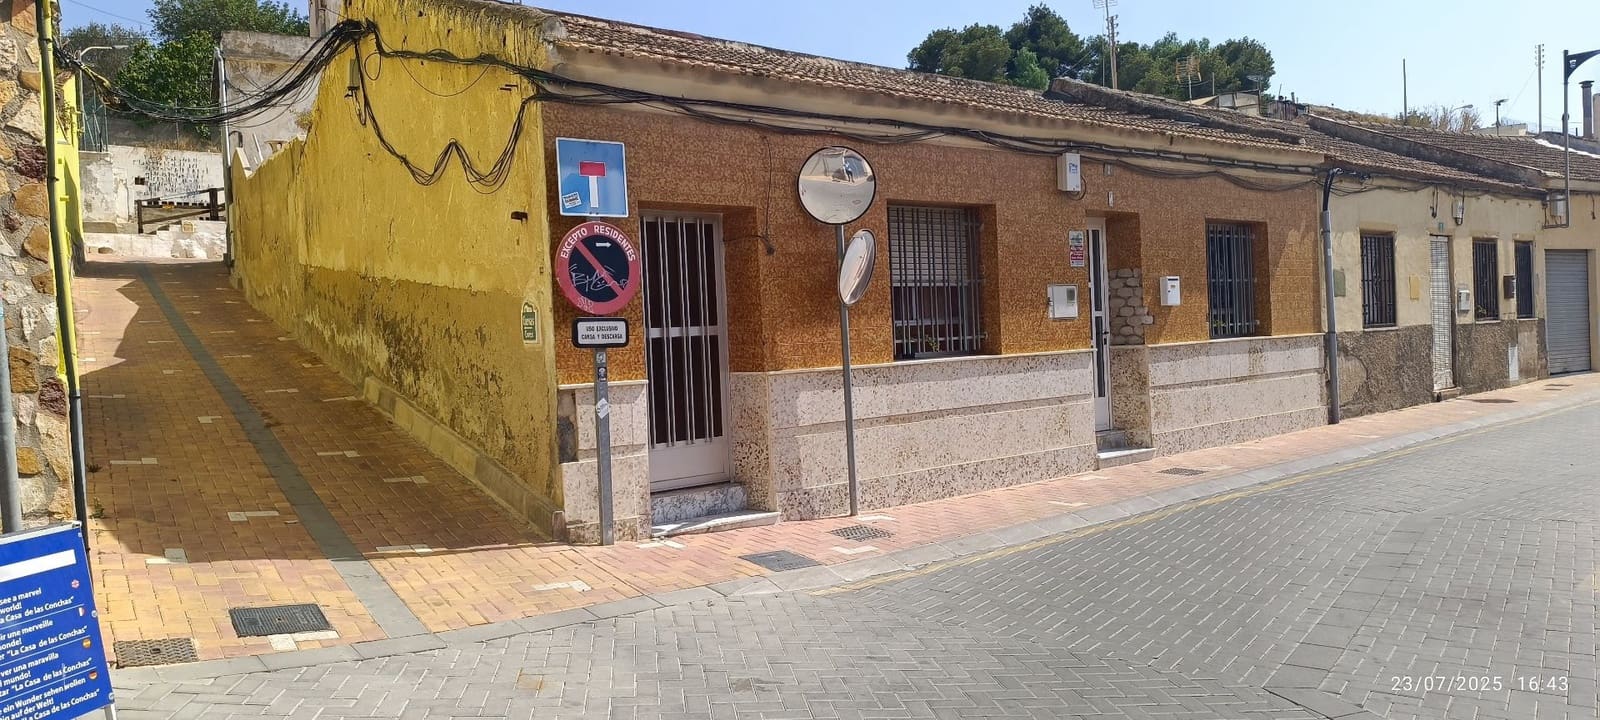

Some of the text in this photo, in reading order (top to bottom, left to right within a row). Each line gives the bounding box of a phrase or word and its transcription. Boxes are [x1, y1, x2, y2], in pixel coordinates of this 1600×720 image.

[560, 225, 636, 262] EXCEPTO RESIDENTES
[18, 587, 42, 600] marvel
[5, 613, 22, 622] Casa
[24, 608, 33, 617] de
[34, 606, 44, 614] las
[7, 630, 21, 639] une
[21, 619, 53, 634] merveille
[20, 644, 36, 653] Casa
[38, 639, 48, 647] de
[0, 652, 59, 677] ver una maravilla
[3, 670, 31, 686] mundo!
[24, 678, 40, 687] Casa
[43, 673, 52, 681] de
[52, 670, 62, 678] las
[3, 704, 15, 713] ein
[14, 695, 42, 708] Wunder
[43, 686, 64, 698] sehen
[64, 677, 86, 691] wollen
[11, 709, 23, 720] auf
[23, 705, 36, 715] der
[35, 698, 54, 710] Welt!
[34, 709, 50, 720] Casa
[51, 705, 60, 713] de
[60, 701, 71, 710] las
